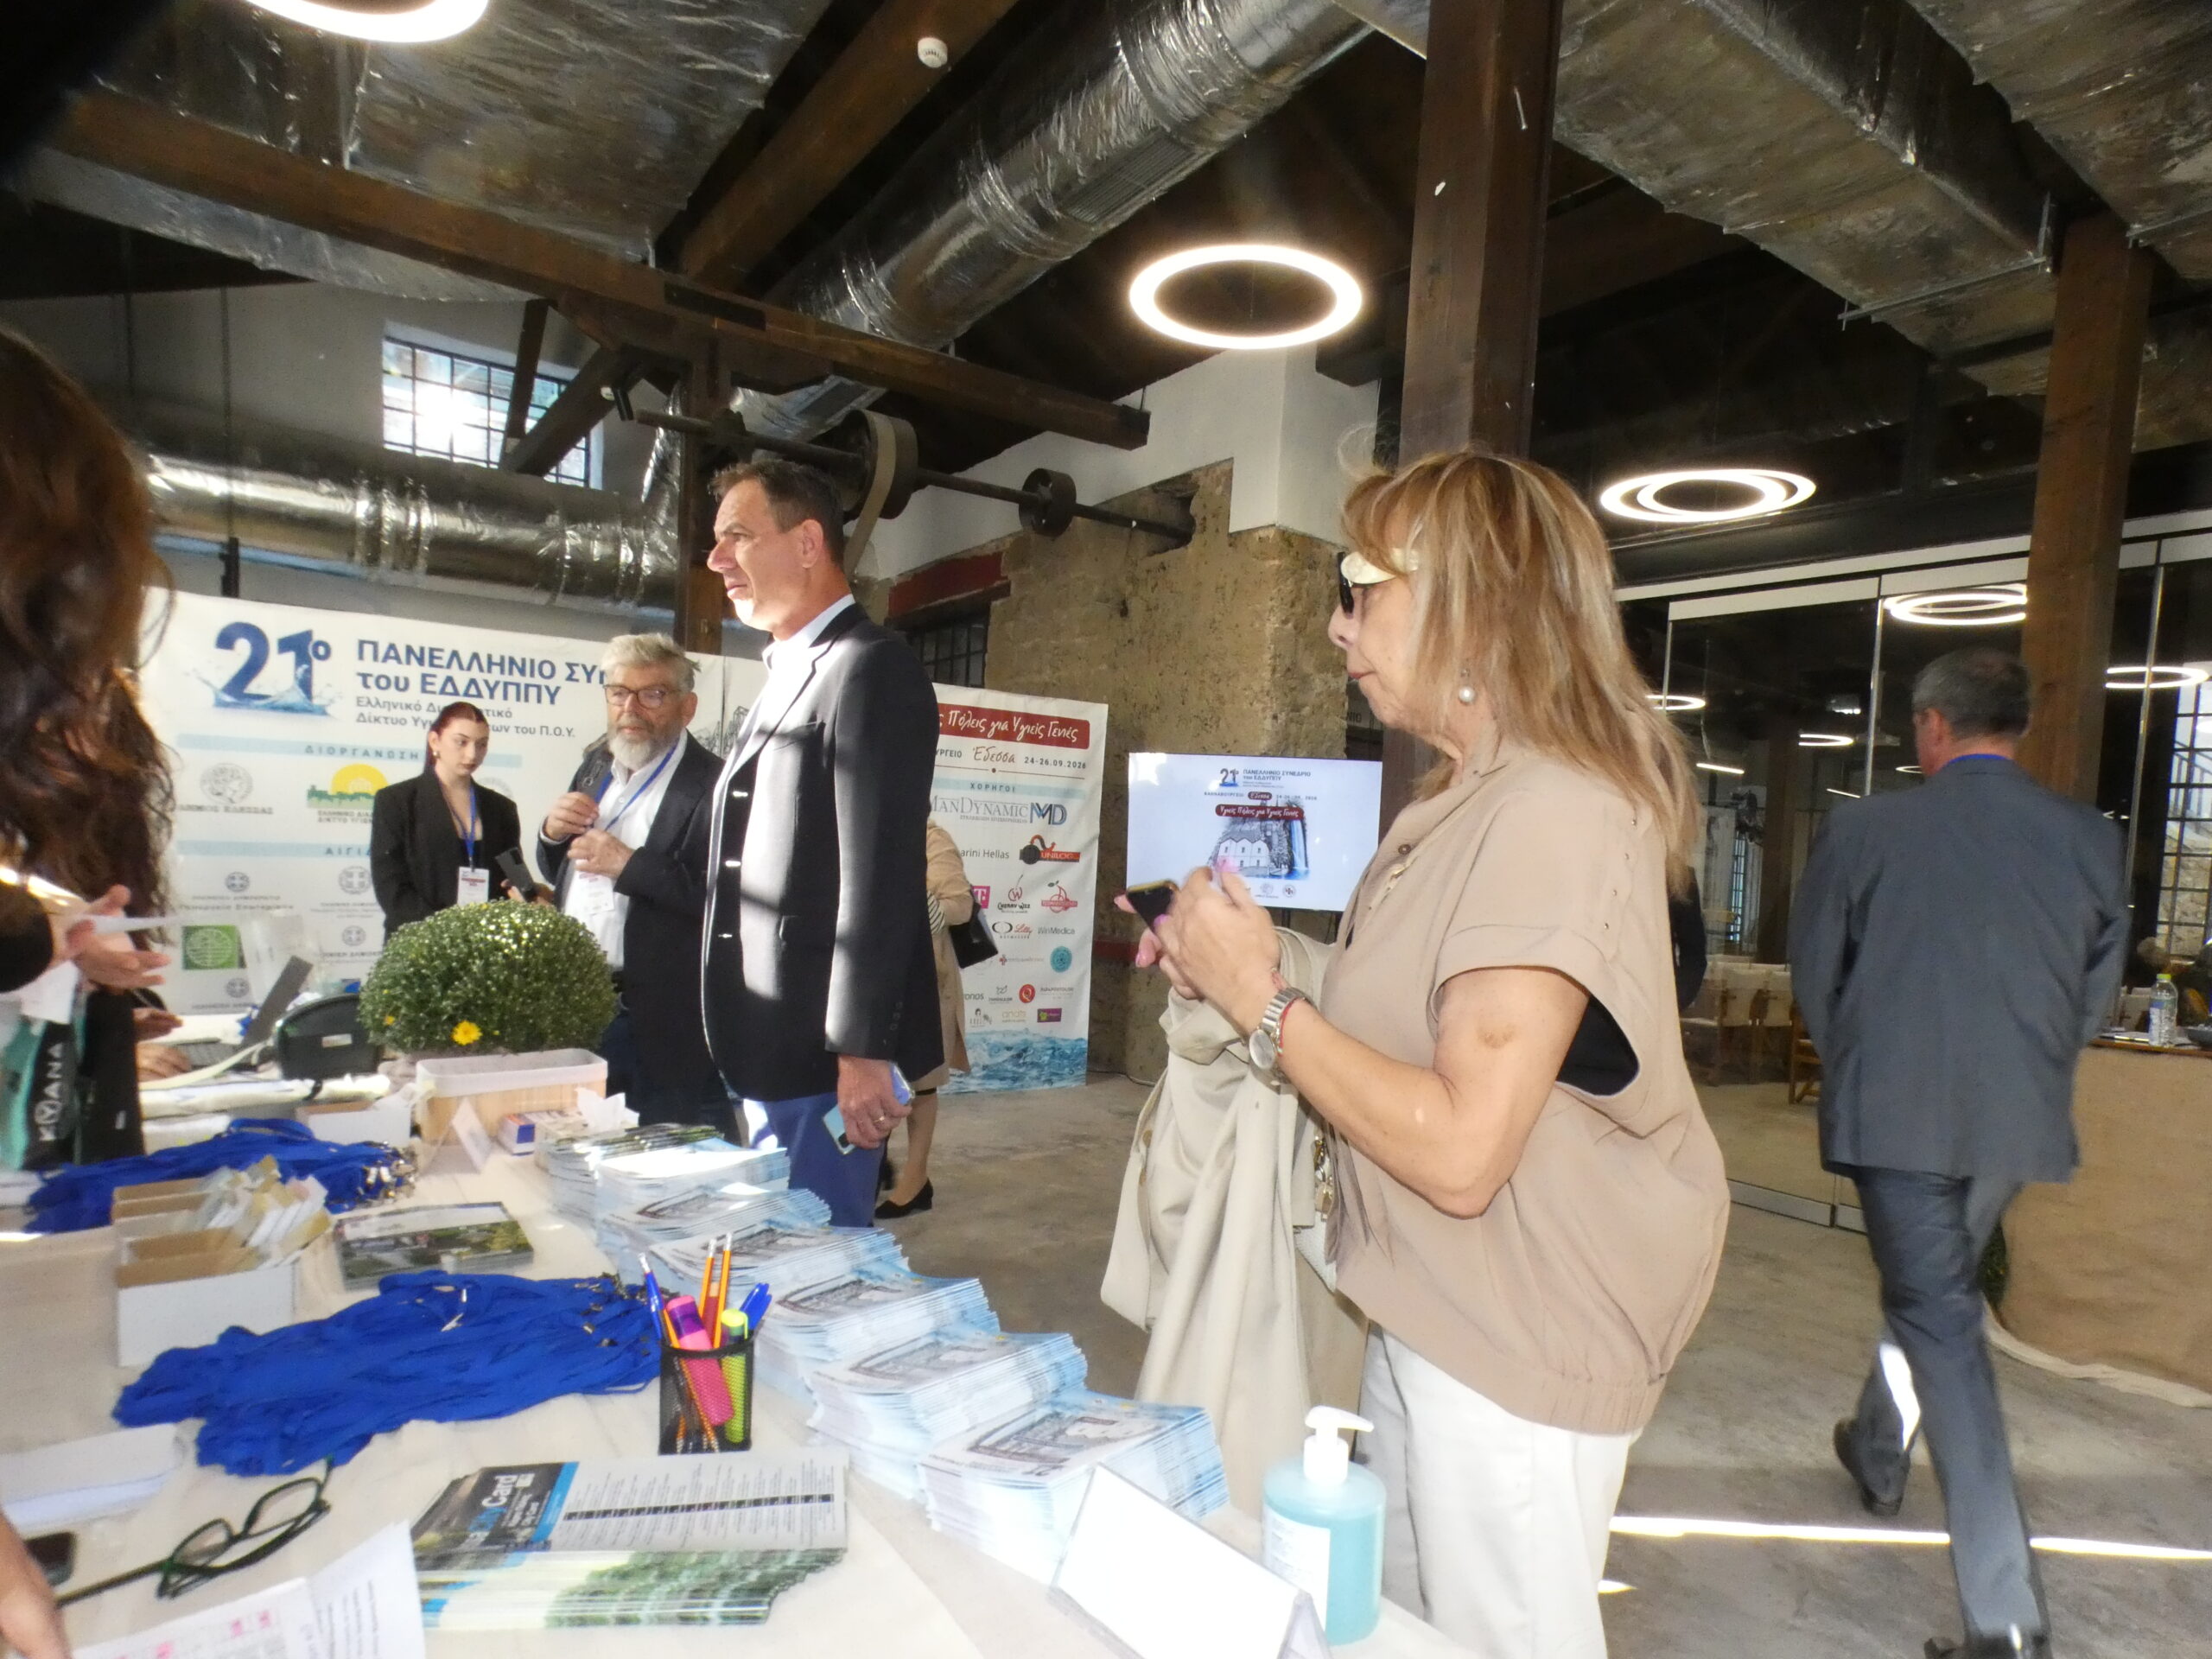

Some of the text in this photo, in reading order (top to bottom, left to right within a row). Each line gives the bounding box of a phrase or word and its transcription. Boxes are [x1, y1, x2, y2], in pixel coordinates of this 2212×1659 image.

[357, 639, 556, 680] ΠΑΝΕΛΛΗΝΙΟ
[356, 671, 562, 705] του ΕΔΔΥΠΠΥ
[356, 696, 422, 711] Ελληνικό
[356, 712, 407, 726] Δίκτυο
[514, 725, 537, 734] του
[539, 725, 575, 737] Π.Ο.Υ.
[949, 710, 988, 733] Πόλεις
[987, 720, 1009, 738] για
[1013, 715, 1046, 741] Υγιείς
[305, 745, 419, 760] ΔΙΟΡΓΑΝΩΣΗ
[937, 748, 963, 758] ΡΓΕΙΟ
[970, 782, 1015, 793] ΧΟΡΗΓΟΙ
[960, 848, 1010, 859] arini Hellas
[480, 1473, 519, 1508] Card
